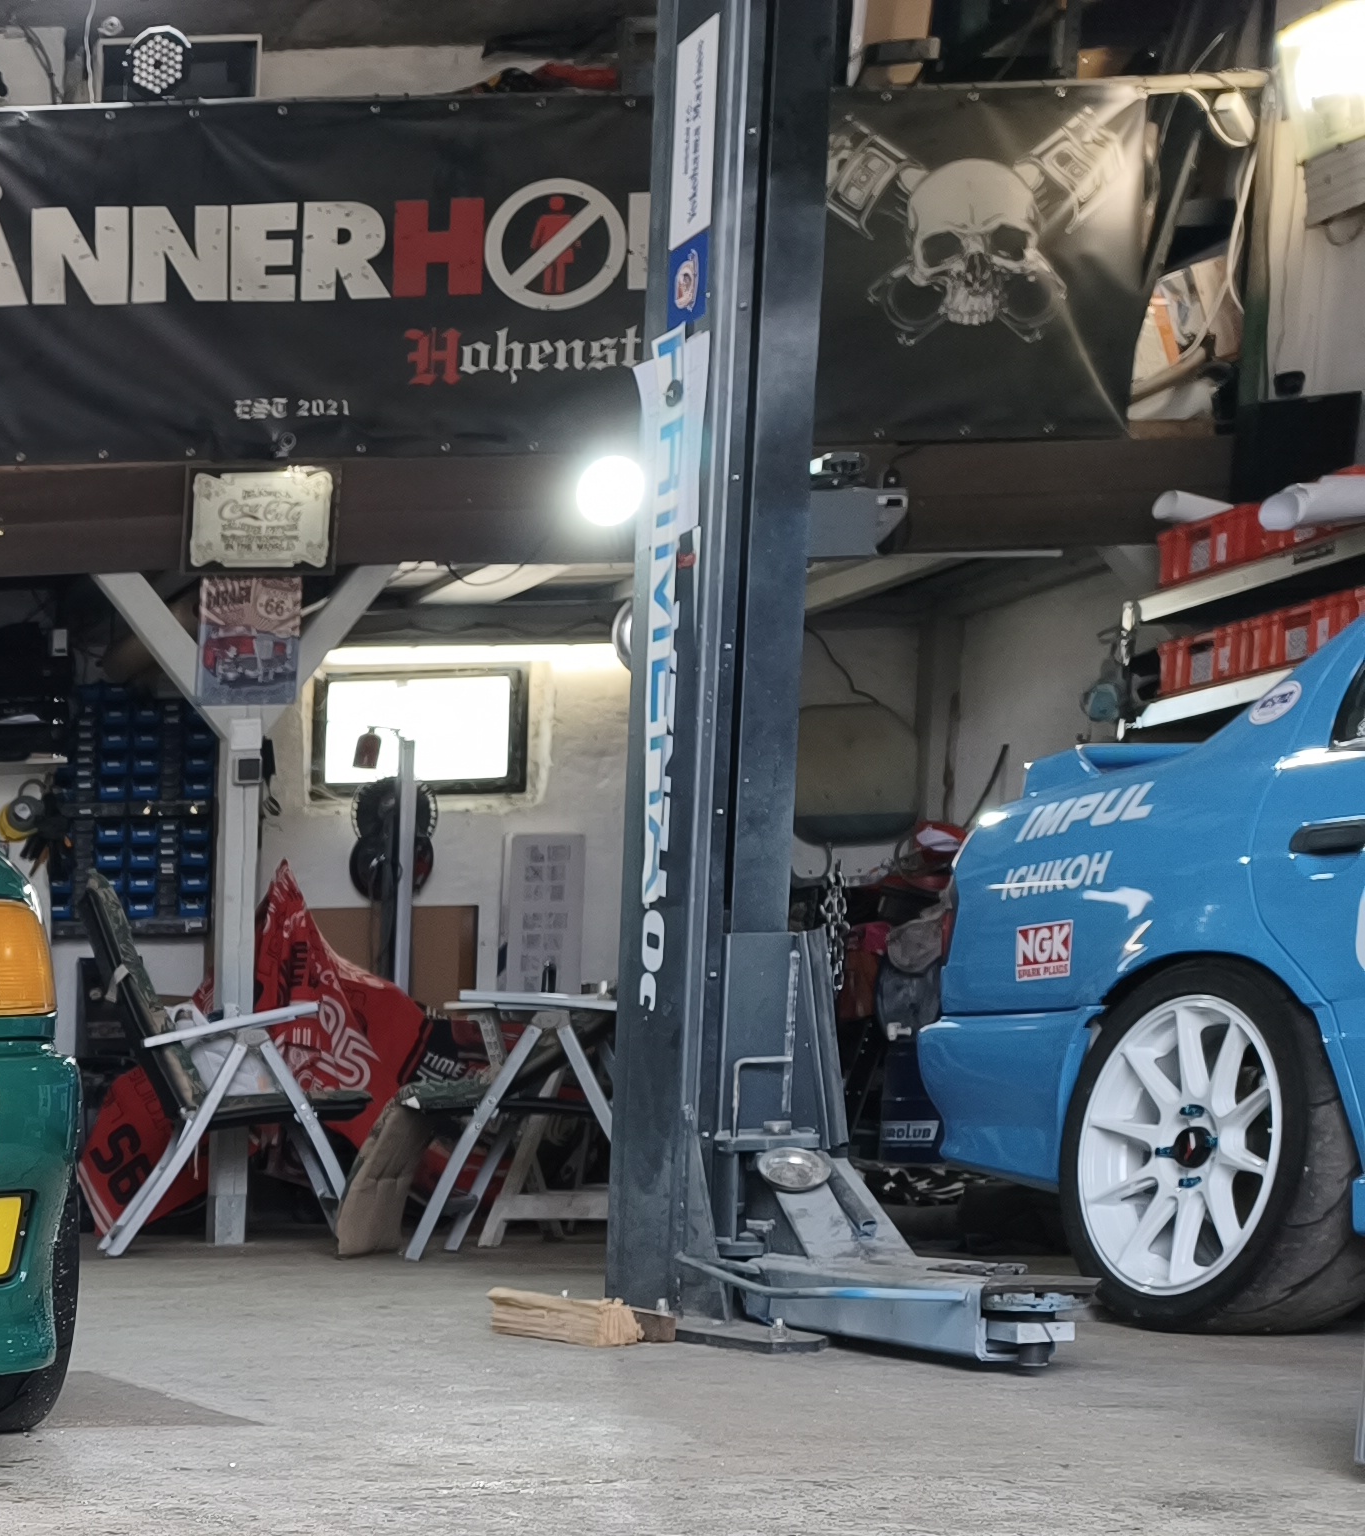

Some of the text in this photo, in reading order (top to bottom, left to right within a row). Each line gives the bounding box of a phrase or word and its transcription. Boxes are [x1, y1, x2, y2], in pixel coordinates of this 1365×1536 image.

[296, 398, 351, 418] 2021
[1015, 780, 1157, 843] IMPUL
[1017, 923, 1072, 966] NGK
